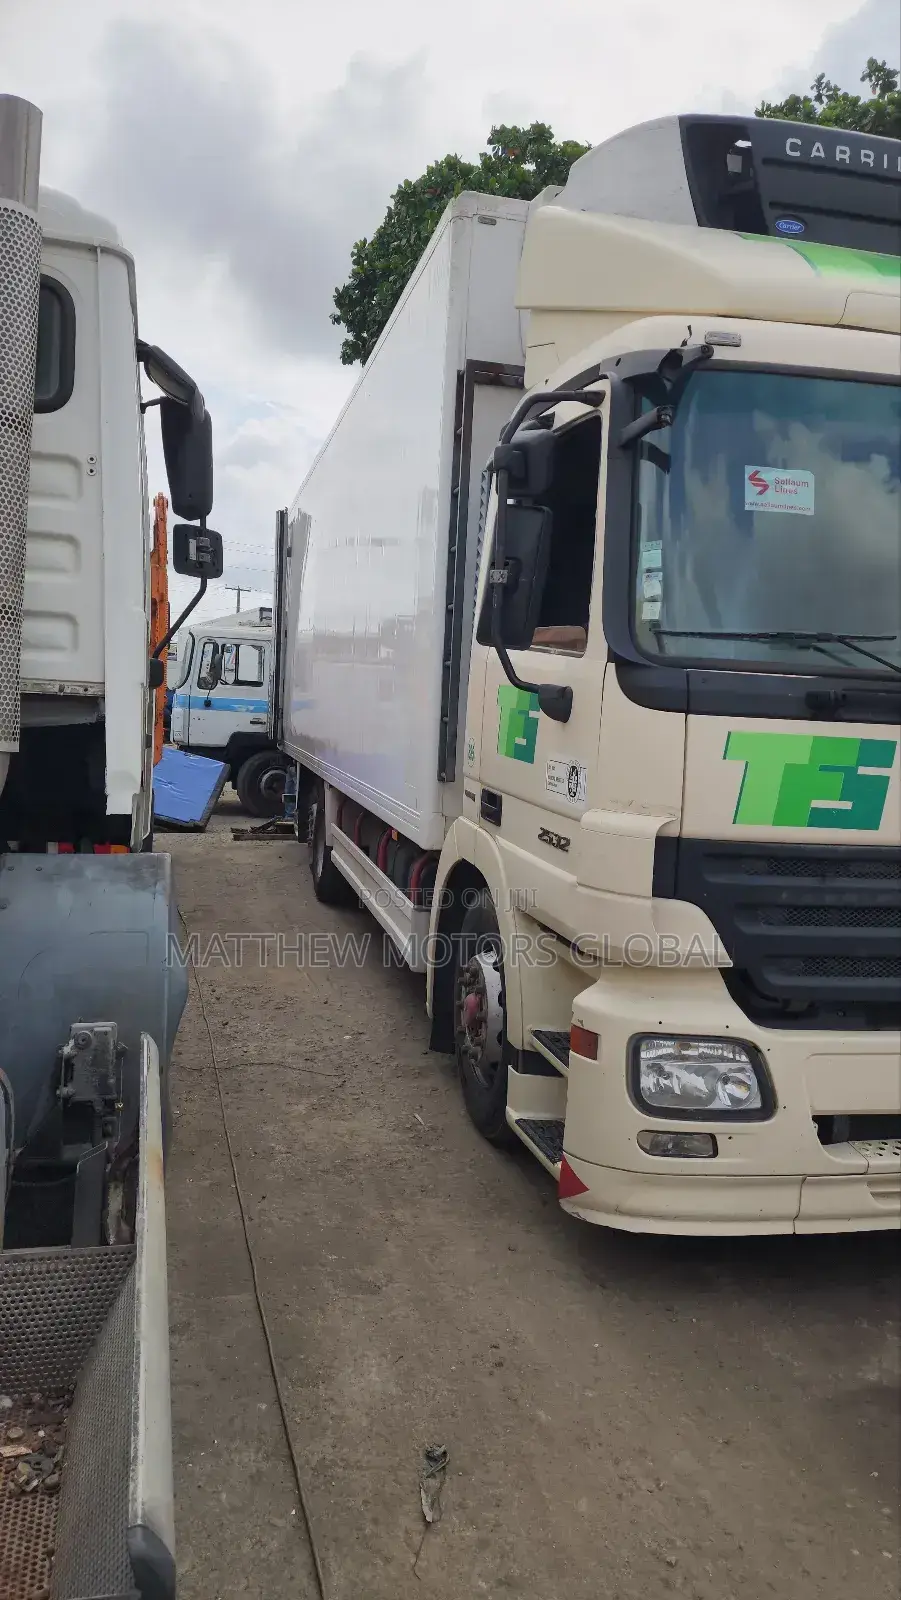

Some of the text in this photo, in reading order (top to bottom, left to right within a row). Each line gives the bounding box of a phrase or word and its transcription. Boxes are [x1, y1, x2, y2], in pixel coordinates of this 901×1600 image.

[785, 137, 901, 172] CARRI
[778, 221, 802, 231] Carrier
[774, 476, 809, 488] Sallaum
[774, 485, 798, 495] Lines
[537, 827, 571, 852] 2532
